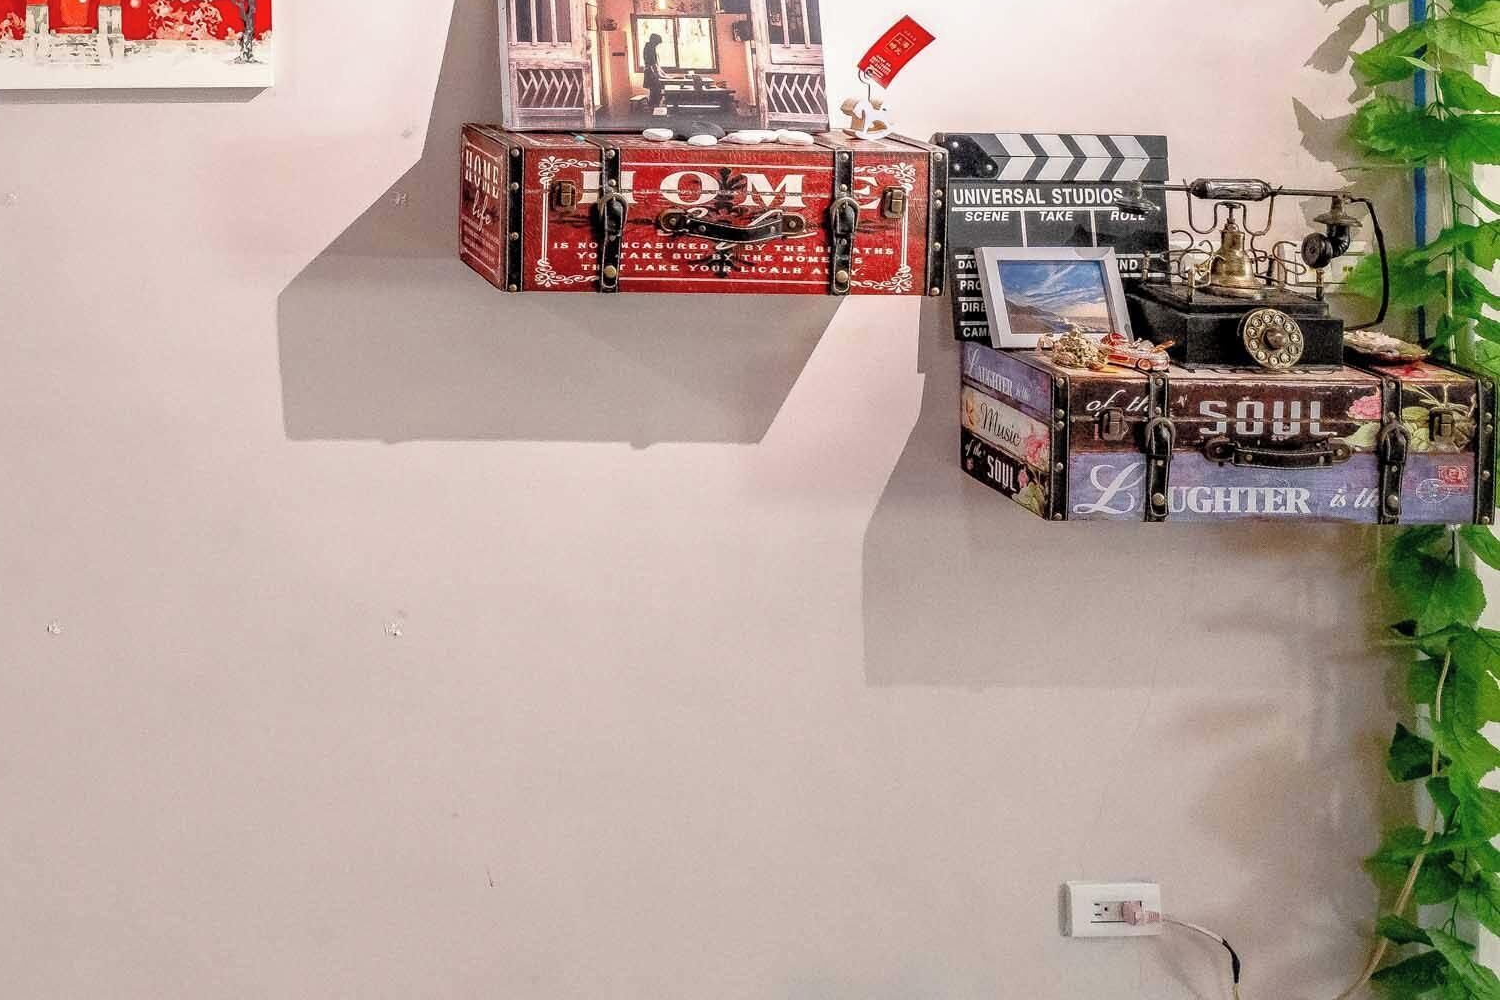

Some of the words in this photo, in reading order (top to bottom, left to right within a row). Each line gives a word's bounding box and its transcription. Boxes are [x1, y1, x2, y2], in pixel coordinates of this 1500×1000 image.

[465, 148, 500, 200] HOME
[953, 188, 1046, 205] UNIVERSAL
[1052, 187, 1124, 205] STUDIOS
[964, 211, 1010, 222] SCENE
[1039, 211, 1074, 222] TAKE
[689, 264, 732, 272] YOUR
[980, 403, 1022, 448] Music
[1199, 399, 1338, 437] SOUL
[986, 454, 1018, 492] SOUL
[1330, 488, 1347, 508] is
